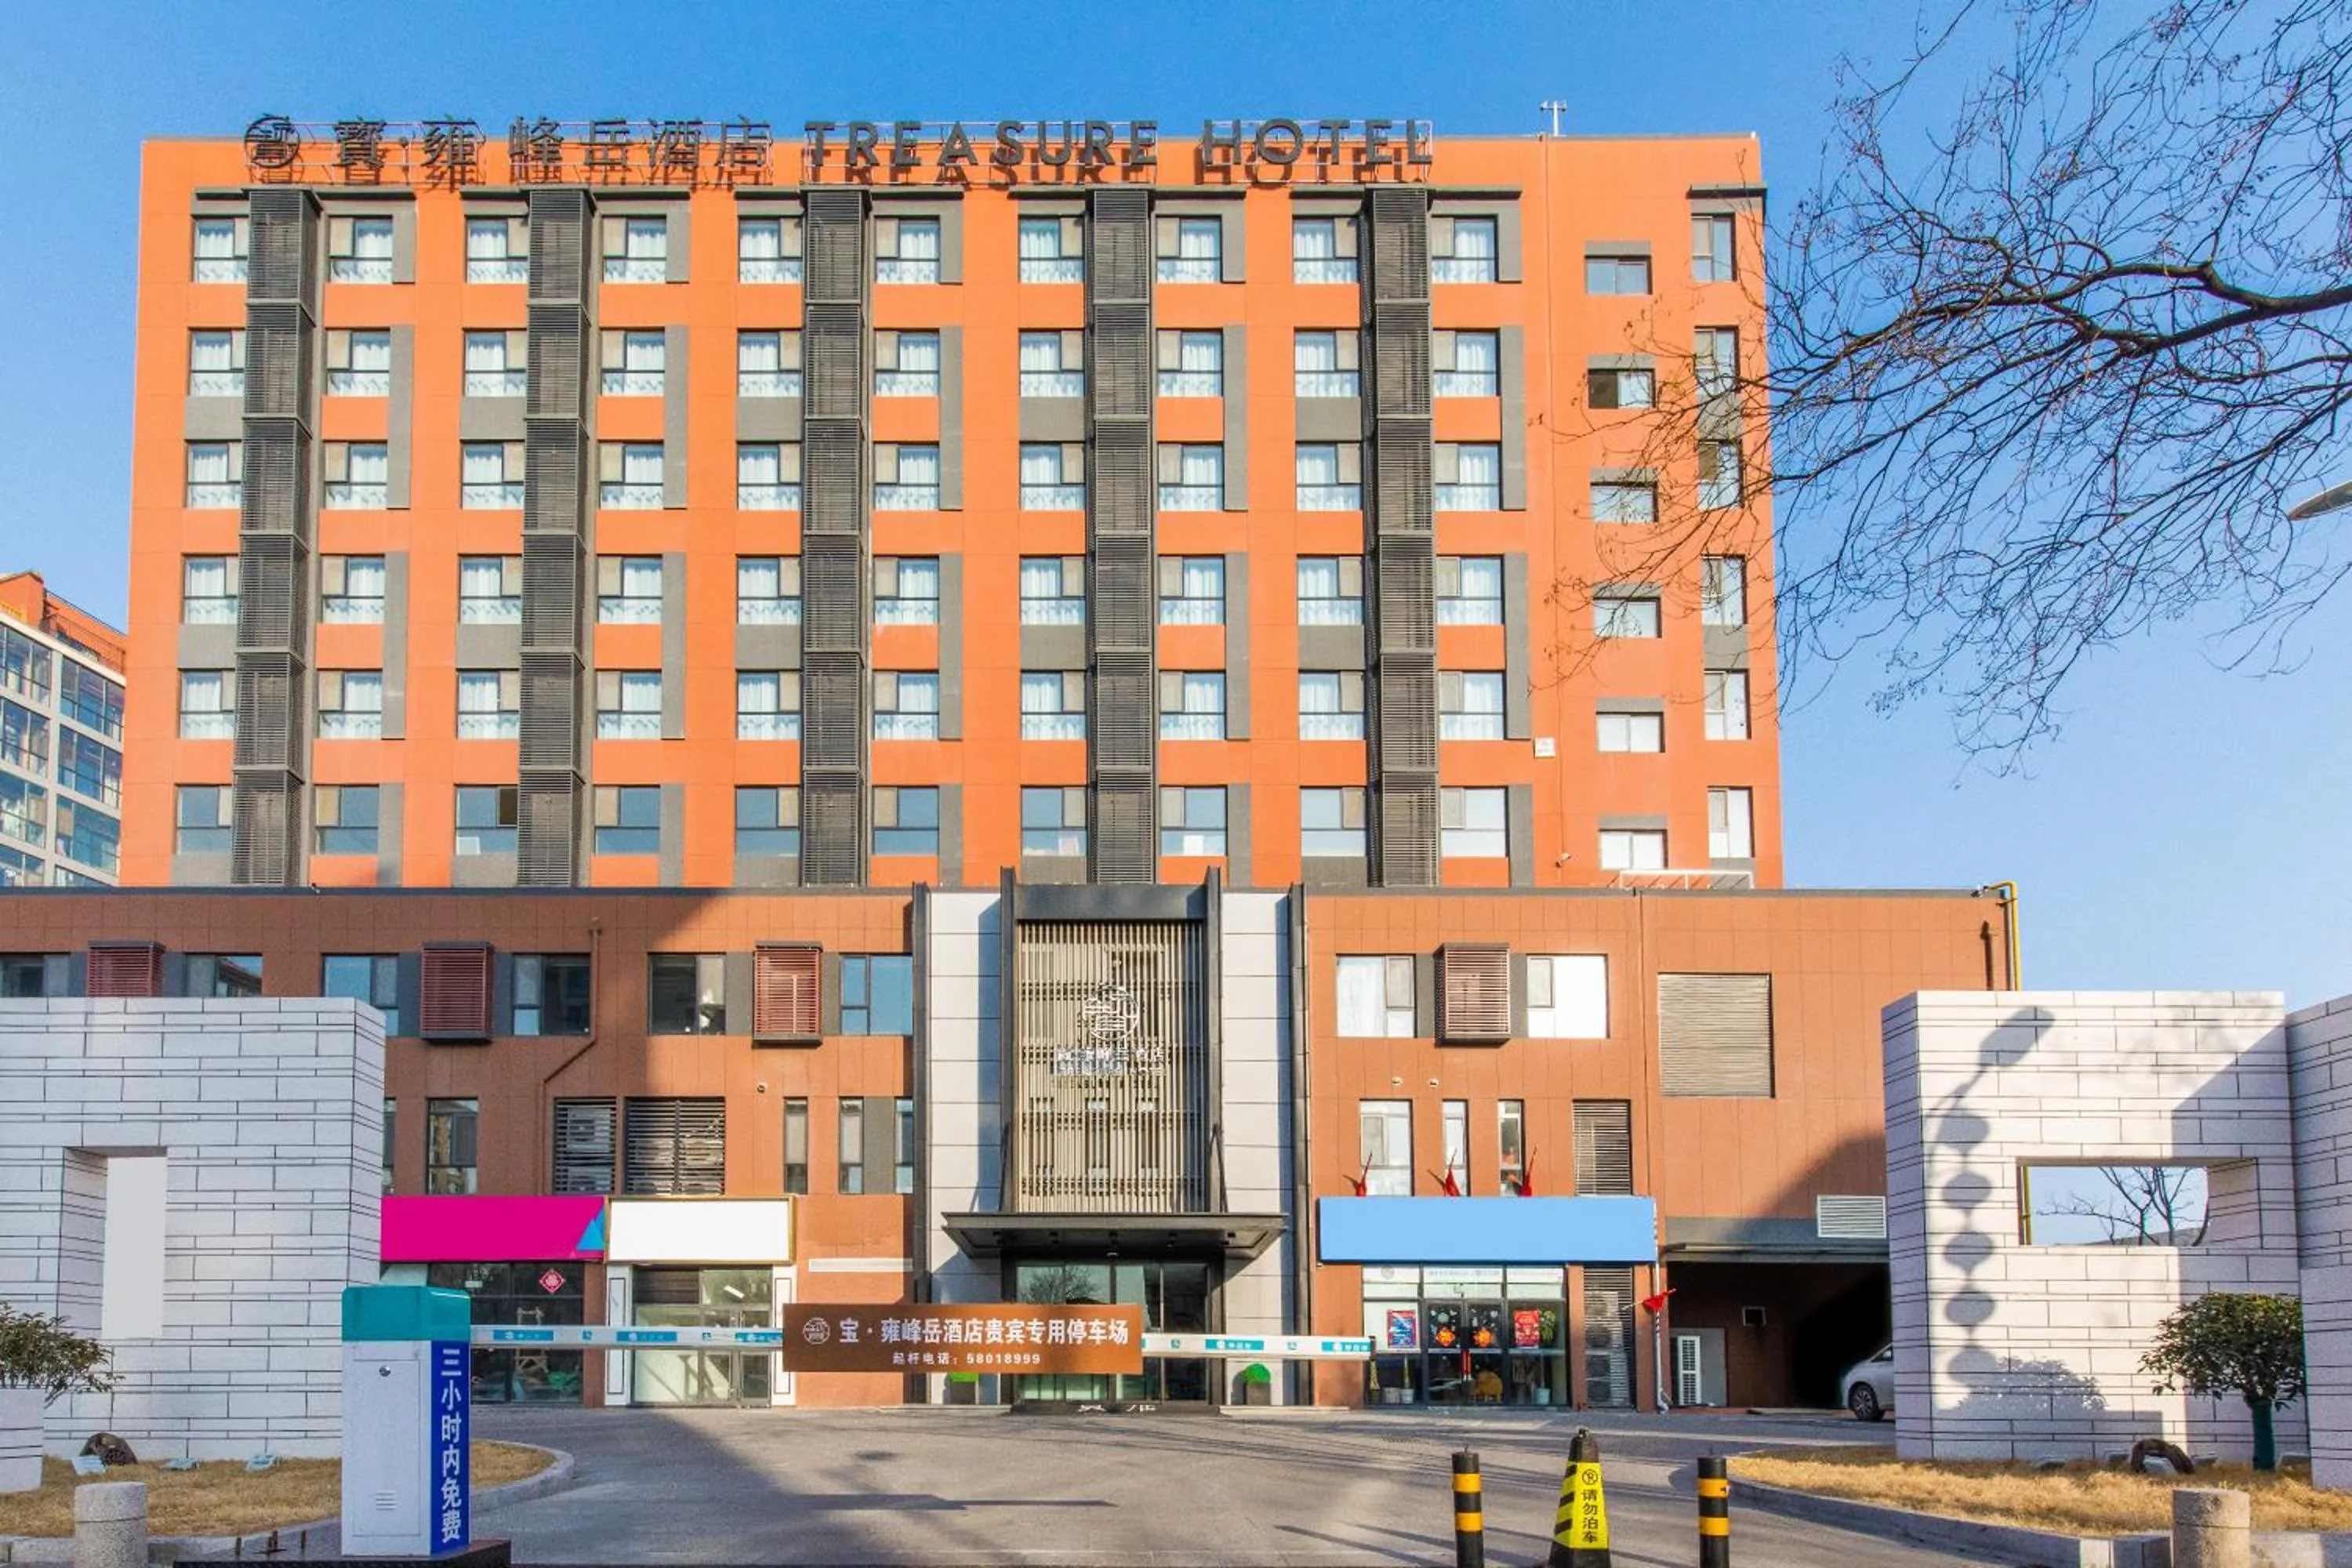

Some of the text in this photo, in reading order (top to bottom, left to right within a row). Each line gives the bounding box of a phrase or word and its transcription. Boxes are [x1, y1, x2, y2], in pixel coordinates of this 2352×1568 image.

[804, 118, 1432, 166] TREASURE HOTEL
[441, 1348, 463, 1543] 三小时内免费
[1581, 1489, 1599, 1544] 请勿泊车
